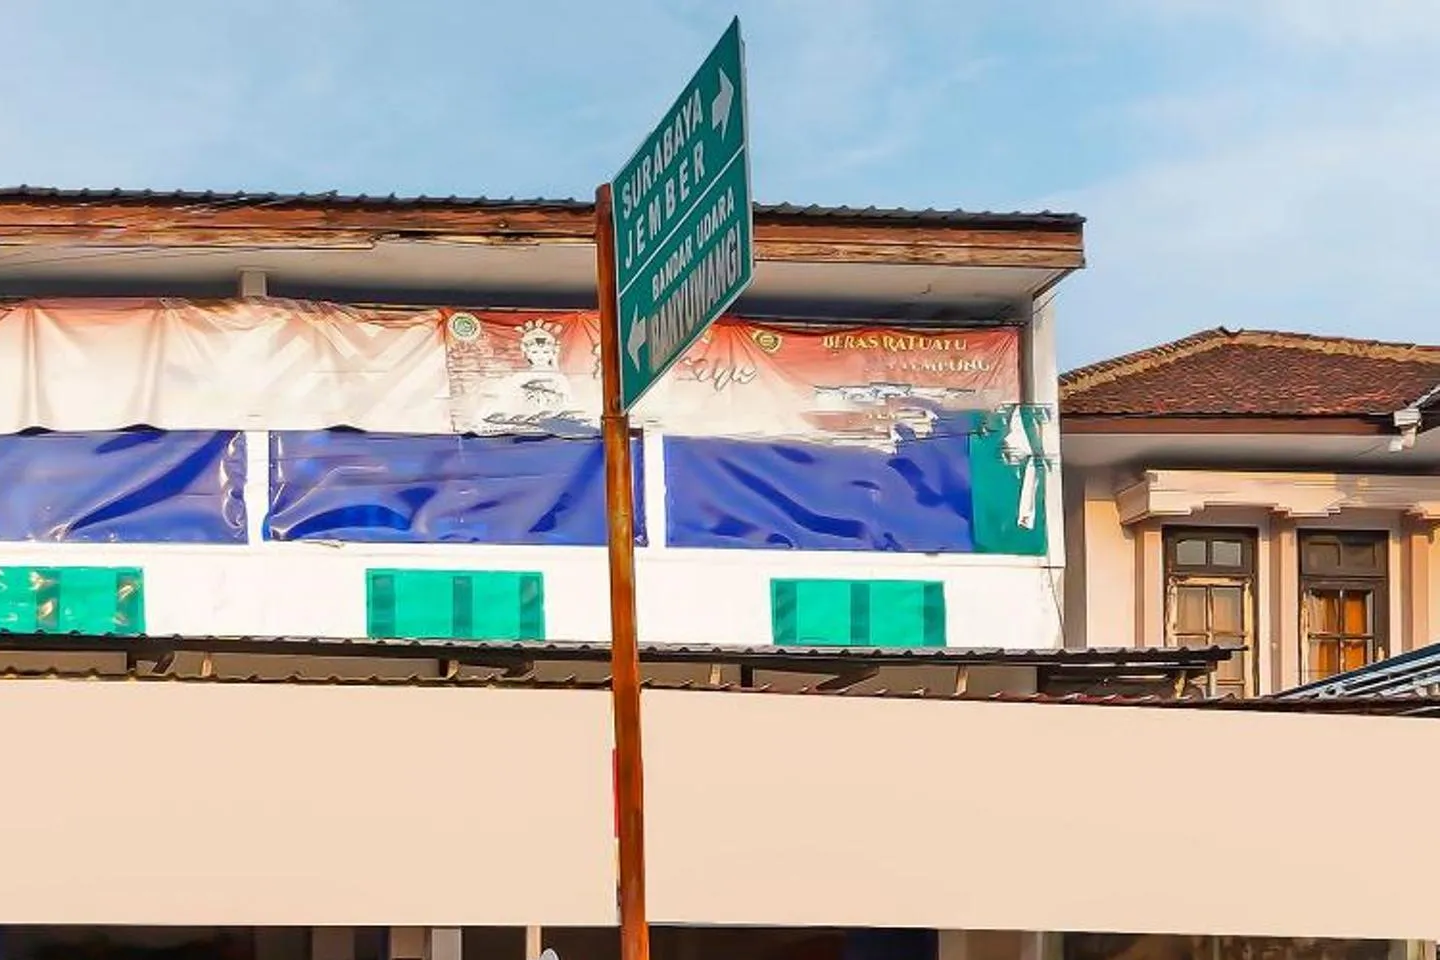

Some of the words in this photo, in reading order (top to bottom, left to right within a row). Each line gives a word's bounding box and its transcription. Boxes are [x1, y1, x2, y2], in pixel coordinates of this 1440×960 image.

[622, 88, 703, 220] SURABAYA
[625, 140, 705, 269] JEMBER
[649, 220, 742, 374] BANYUWANGI
[652, 234, 693, 301] BANDAR
[696, 186, 735, 251] UDARA
